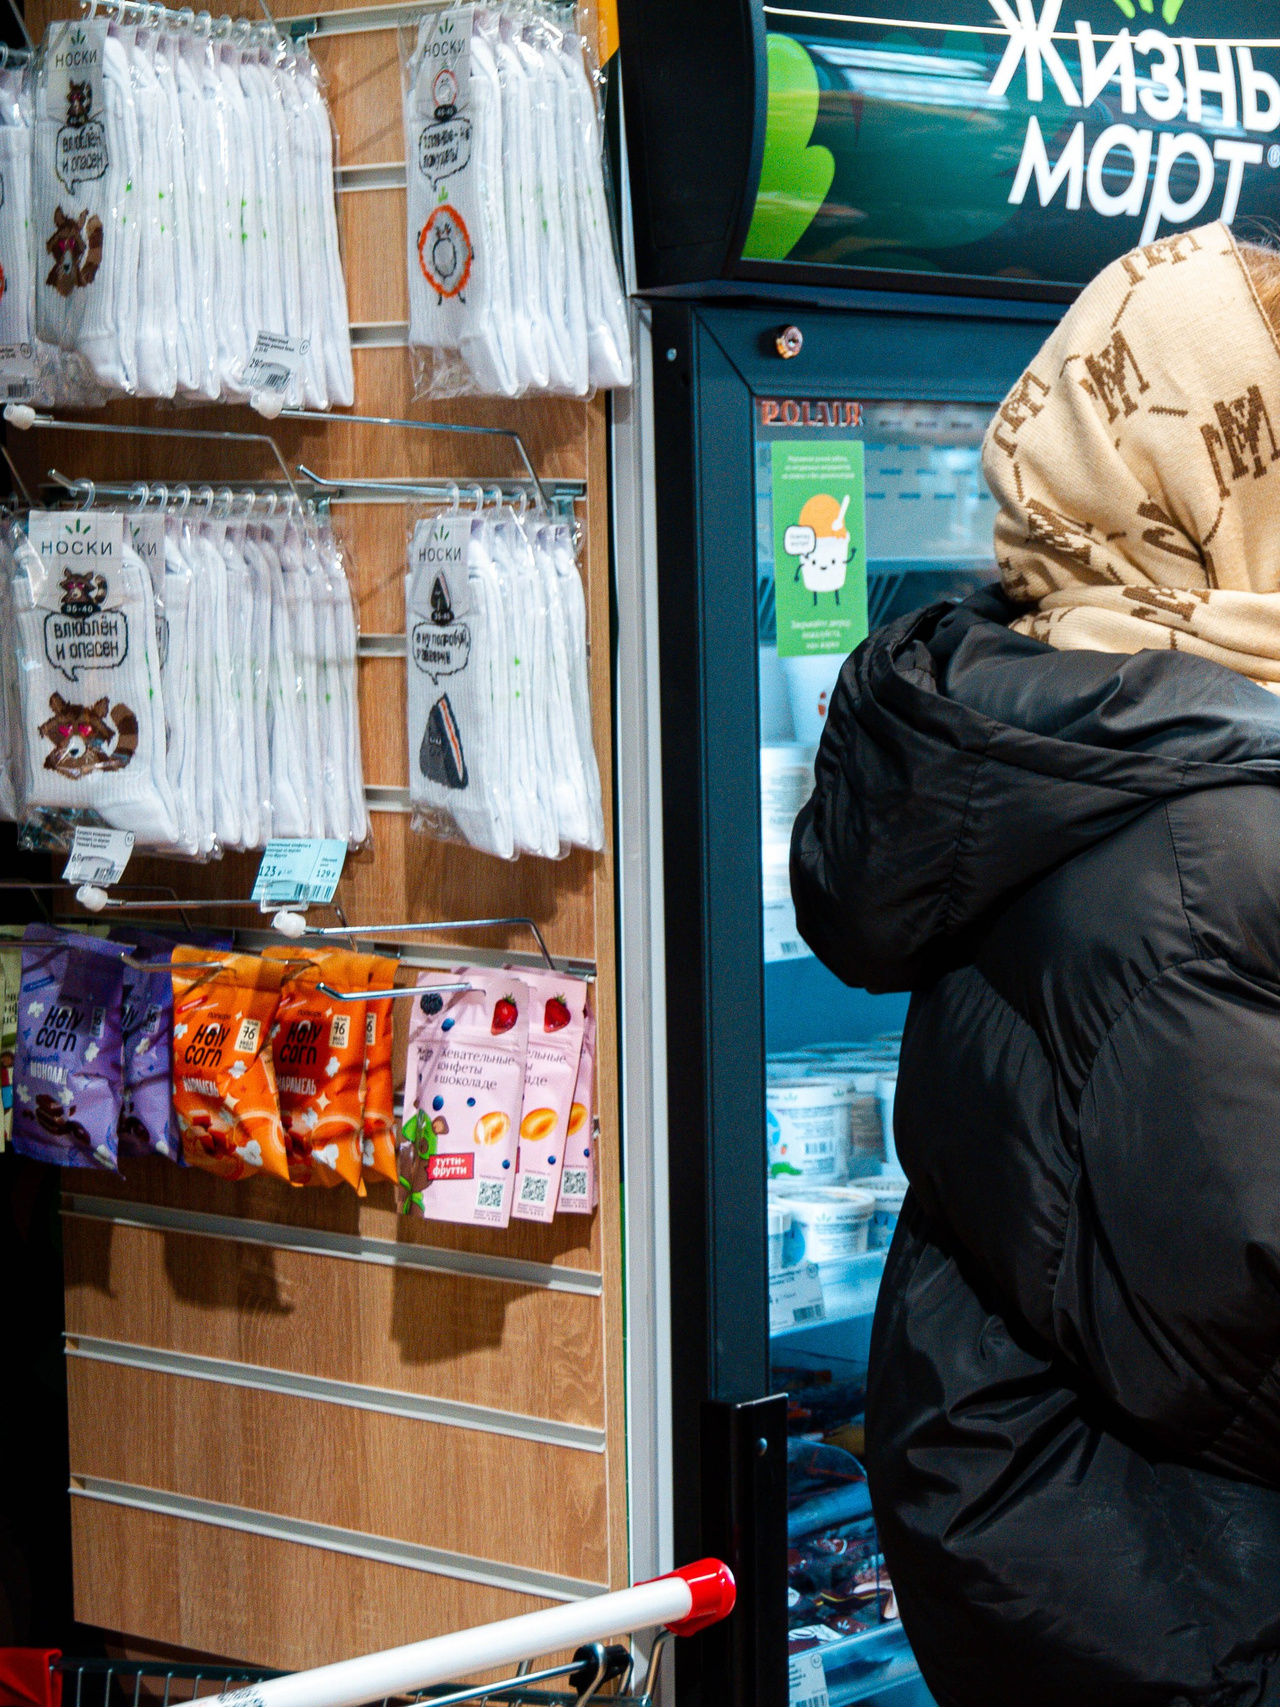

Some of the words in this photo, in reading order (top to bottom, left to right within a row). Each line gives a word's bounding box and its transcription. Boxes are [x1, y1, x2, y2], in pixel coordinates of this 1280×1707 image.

[424, 39, 465, 58] НОСКИ
[55, 49, 98, 68] НОСКИ
[761, 399, 864, 427] POLAIR
[41, 541, 112, 556] НОСКИ
[418, 546, 462, 562] НОСКИ
[54, 615, 118, 639] влюблён
[55, 643, 65, 660] и
[69, 641, 119, 659] опасен
[259, 866, 277, 877] 123
[316, 869, 331, 878] 129
[242, 1025, 255, 1040] 76
[333, 1022, 345, 1035] 76
[435, 1156, 465, 1167] тутти-
[432, 1165, 467, 1177] фрутти
